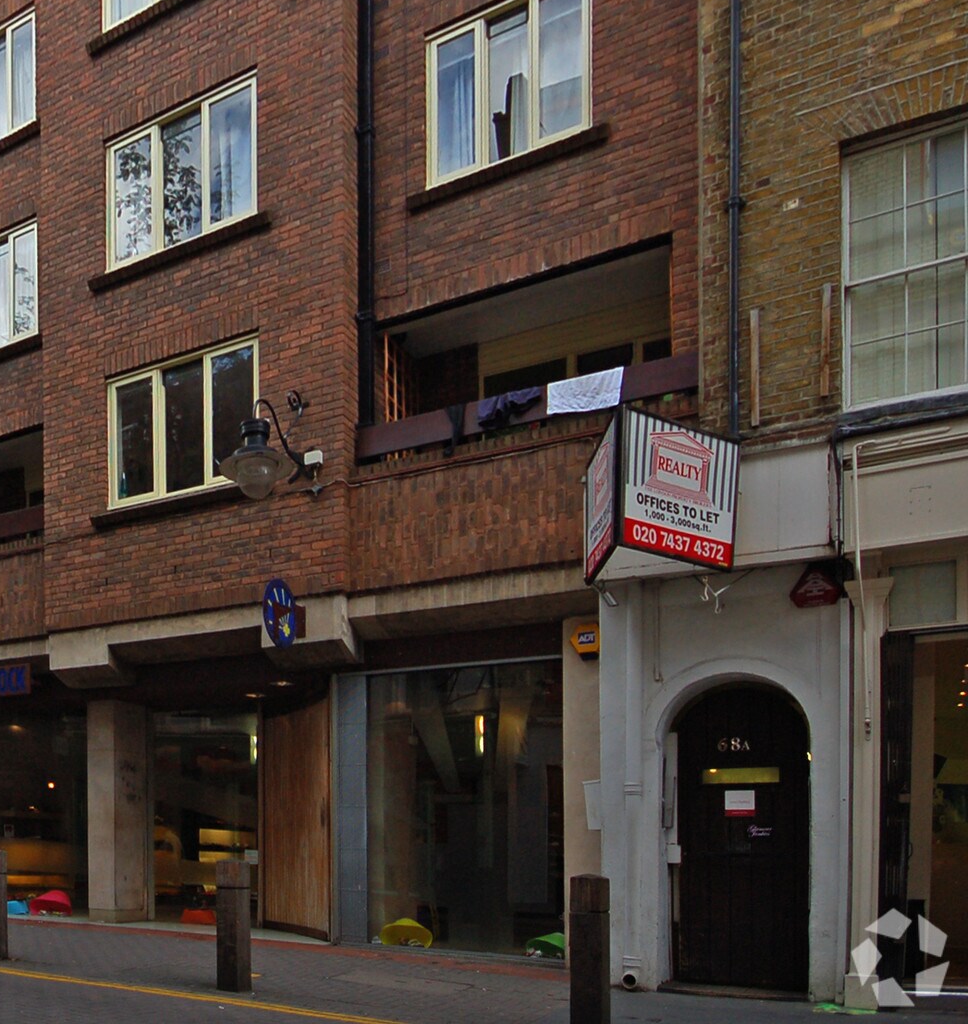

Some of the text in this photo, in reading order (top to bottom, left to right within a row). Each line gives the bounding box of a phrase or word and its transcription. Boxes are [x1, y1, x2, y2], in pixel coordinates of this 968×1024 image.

[658, 455, 702, 481] REALTY
[636, 492, 680, 514] OFFICES
[682, 505, 697, 519] TO
[700, 509, 720, 524] LET
[644, 509, 665, 522] 1,000
[632, 524, 657, 544] 020
[660, 531, 691, 552] 7437
[693, 540, 724, 560] 4372
[578, 633, 595, 643] ADT
[717, 737, 750, 751] 68A
